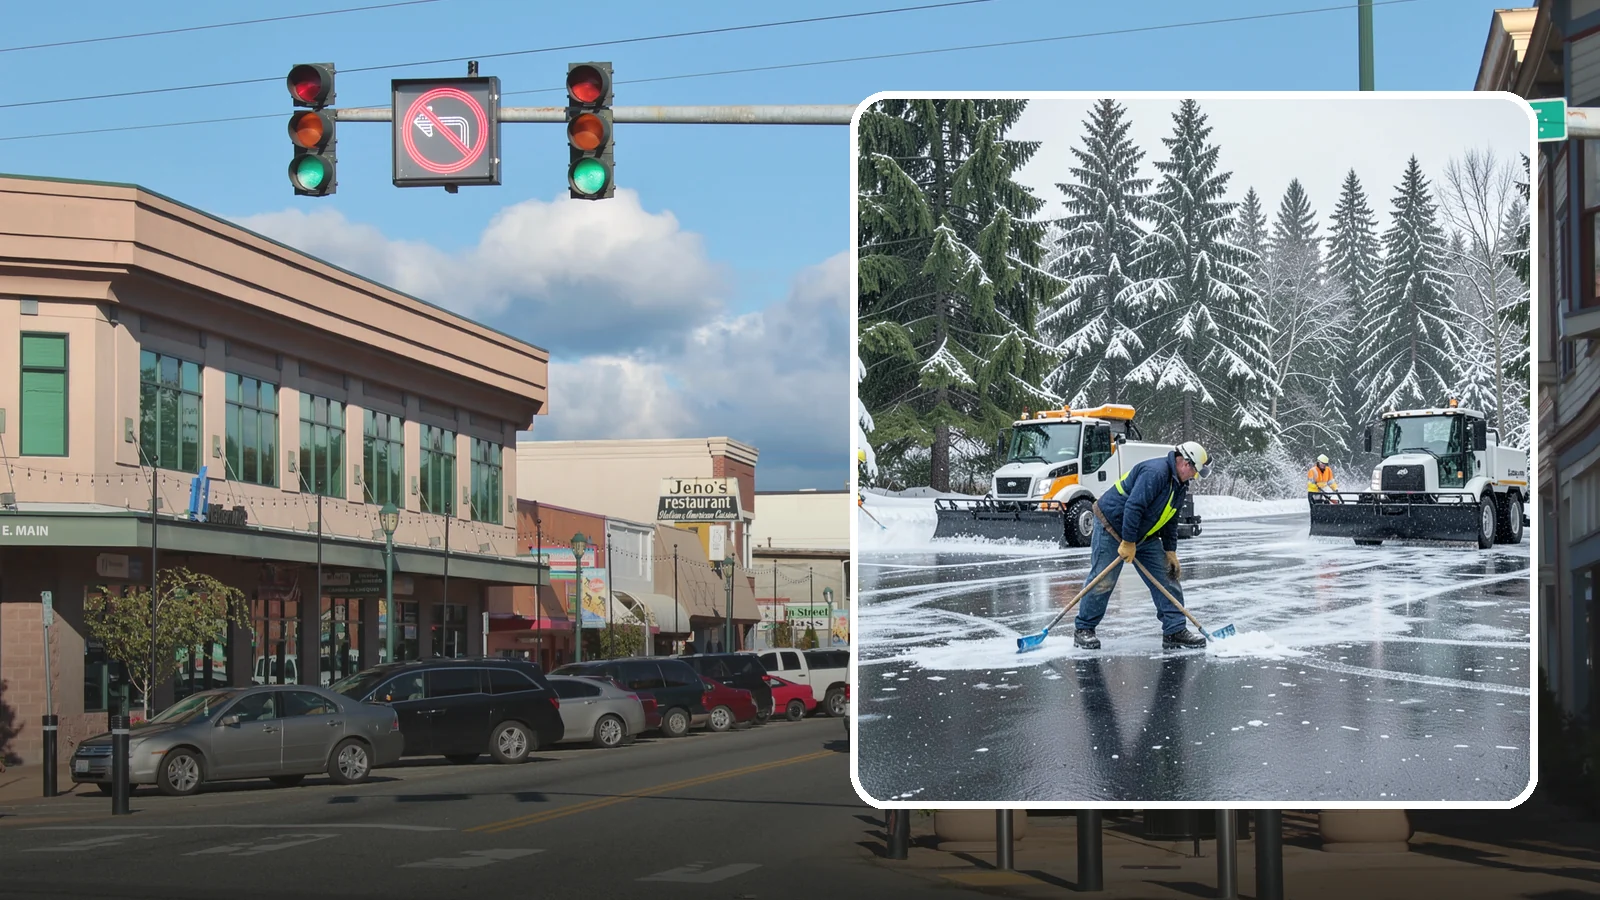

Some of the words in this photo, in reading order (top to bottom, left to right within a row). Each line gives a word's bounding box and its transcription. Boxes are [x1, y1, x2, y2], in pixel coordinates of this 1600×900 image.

[669, 480, 727, 495] Jeno's
[665, 496, 731, 509] restaurant
[659, 509, 682, 520] Italian
[685, 509, 714, 520] American
[714, 509, 738, 520] Cuisine
[2, 525, 13, 536] E.
[15, 525, 49, 537] MAIN
[797, 607, 828, 617] Street
[790, 619, 824, 627] lass
